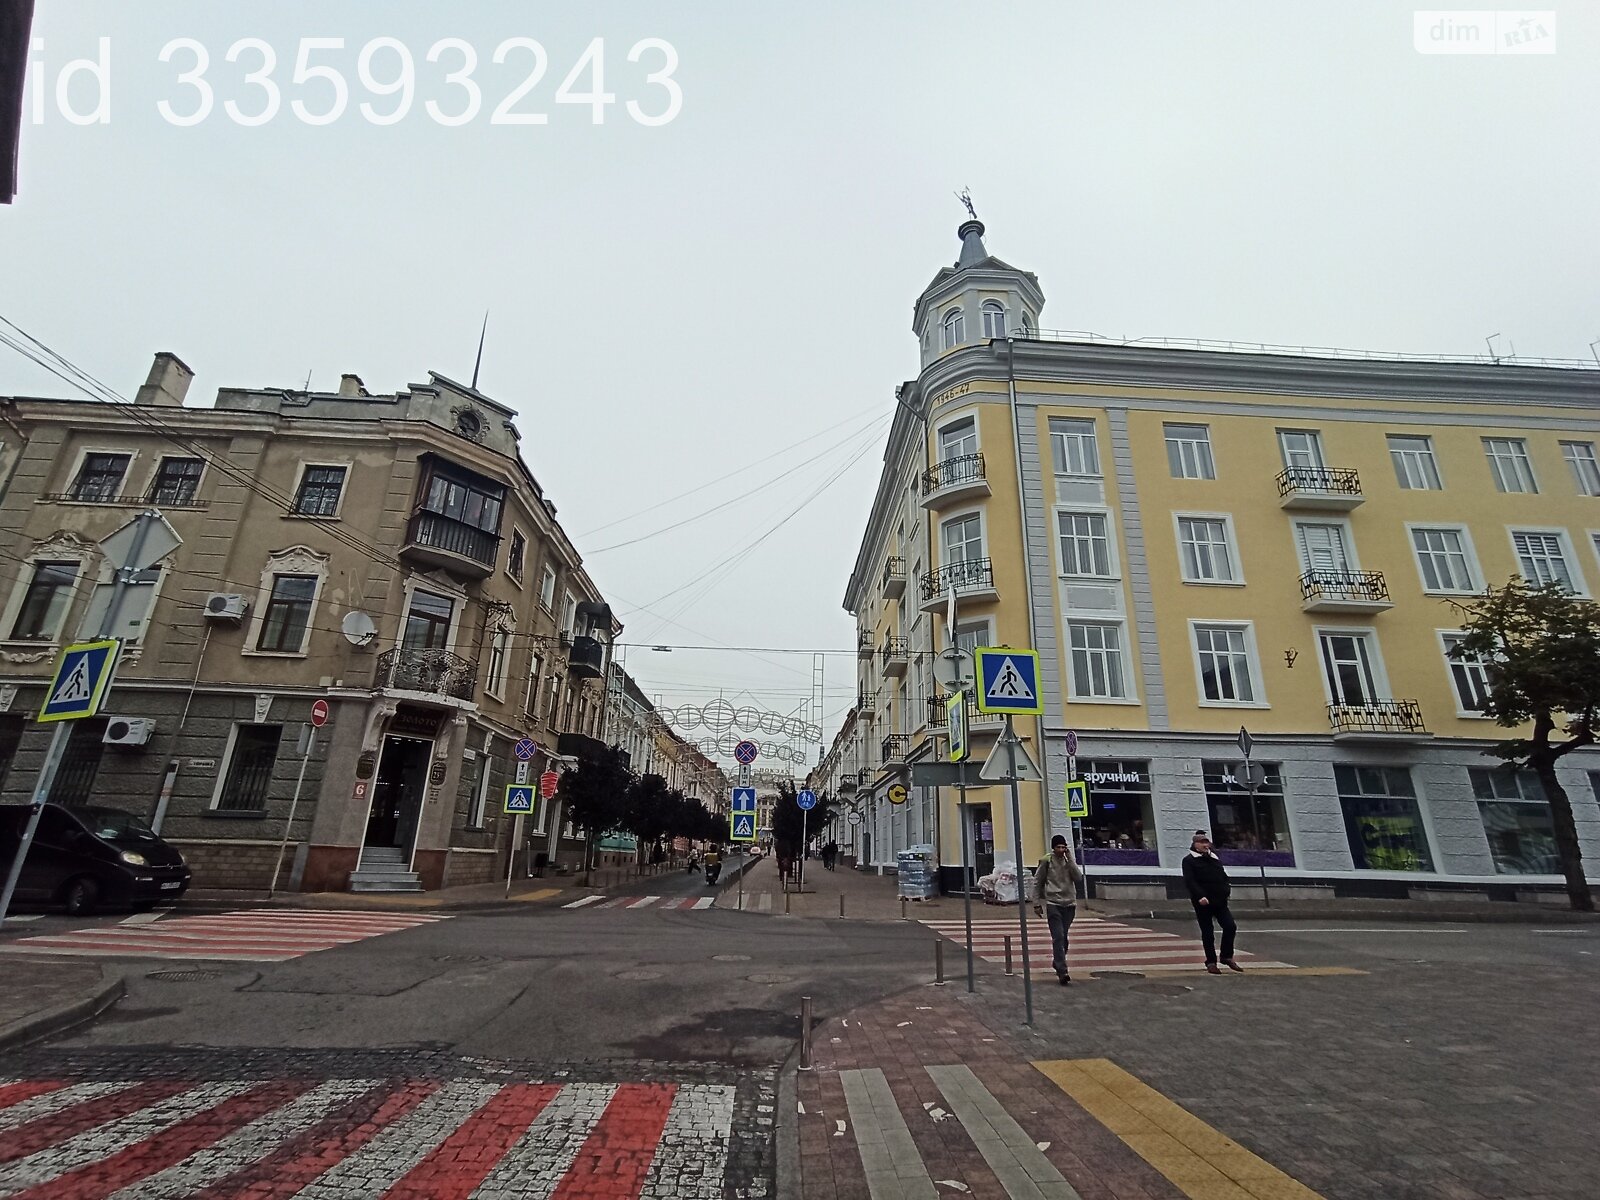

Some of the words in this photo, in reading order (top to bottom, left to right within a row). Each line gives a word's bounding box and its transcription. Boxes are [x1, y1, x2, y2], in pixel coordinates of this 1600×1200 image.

[936, 383, 971, 405] 1946-47
[1084, 771, 1140, 784] зручний
[356, 784, 365, 795] 6
